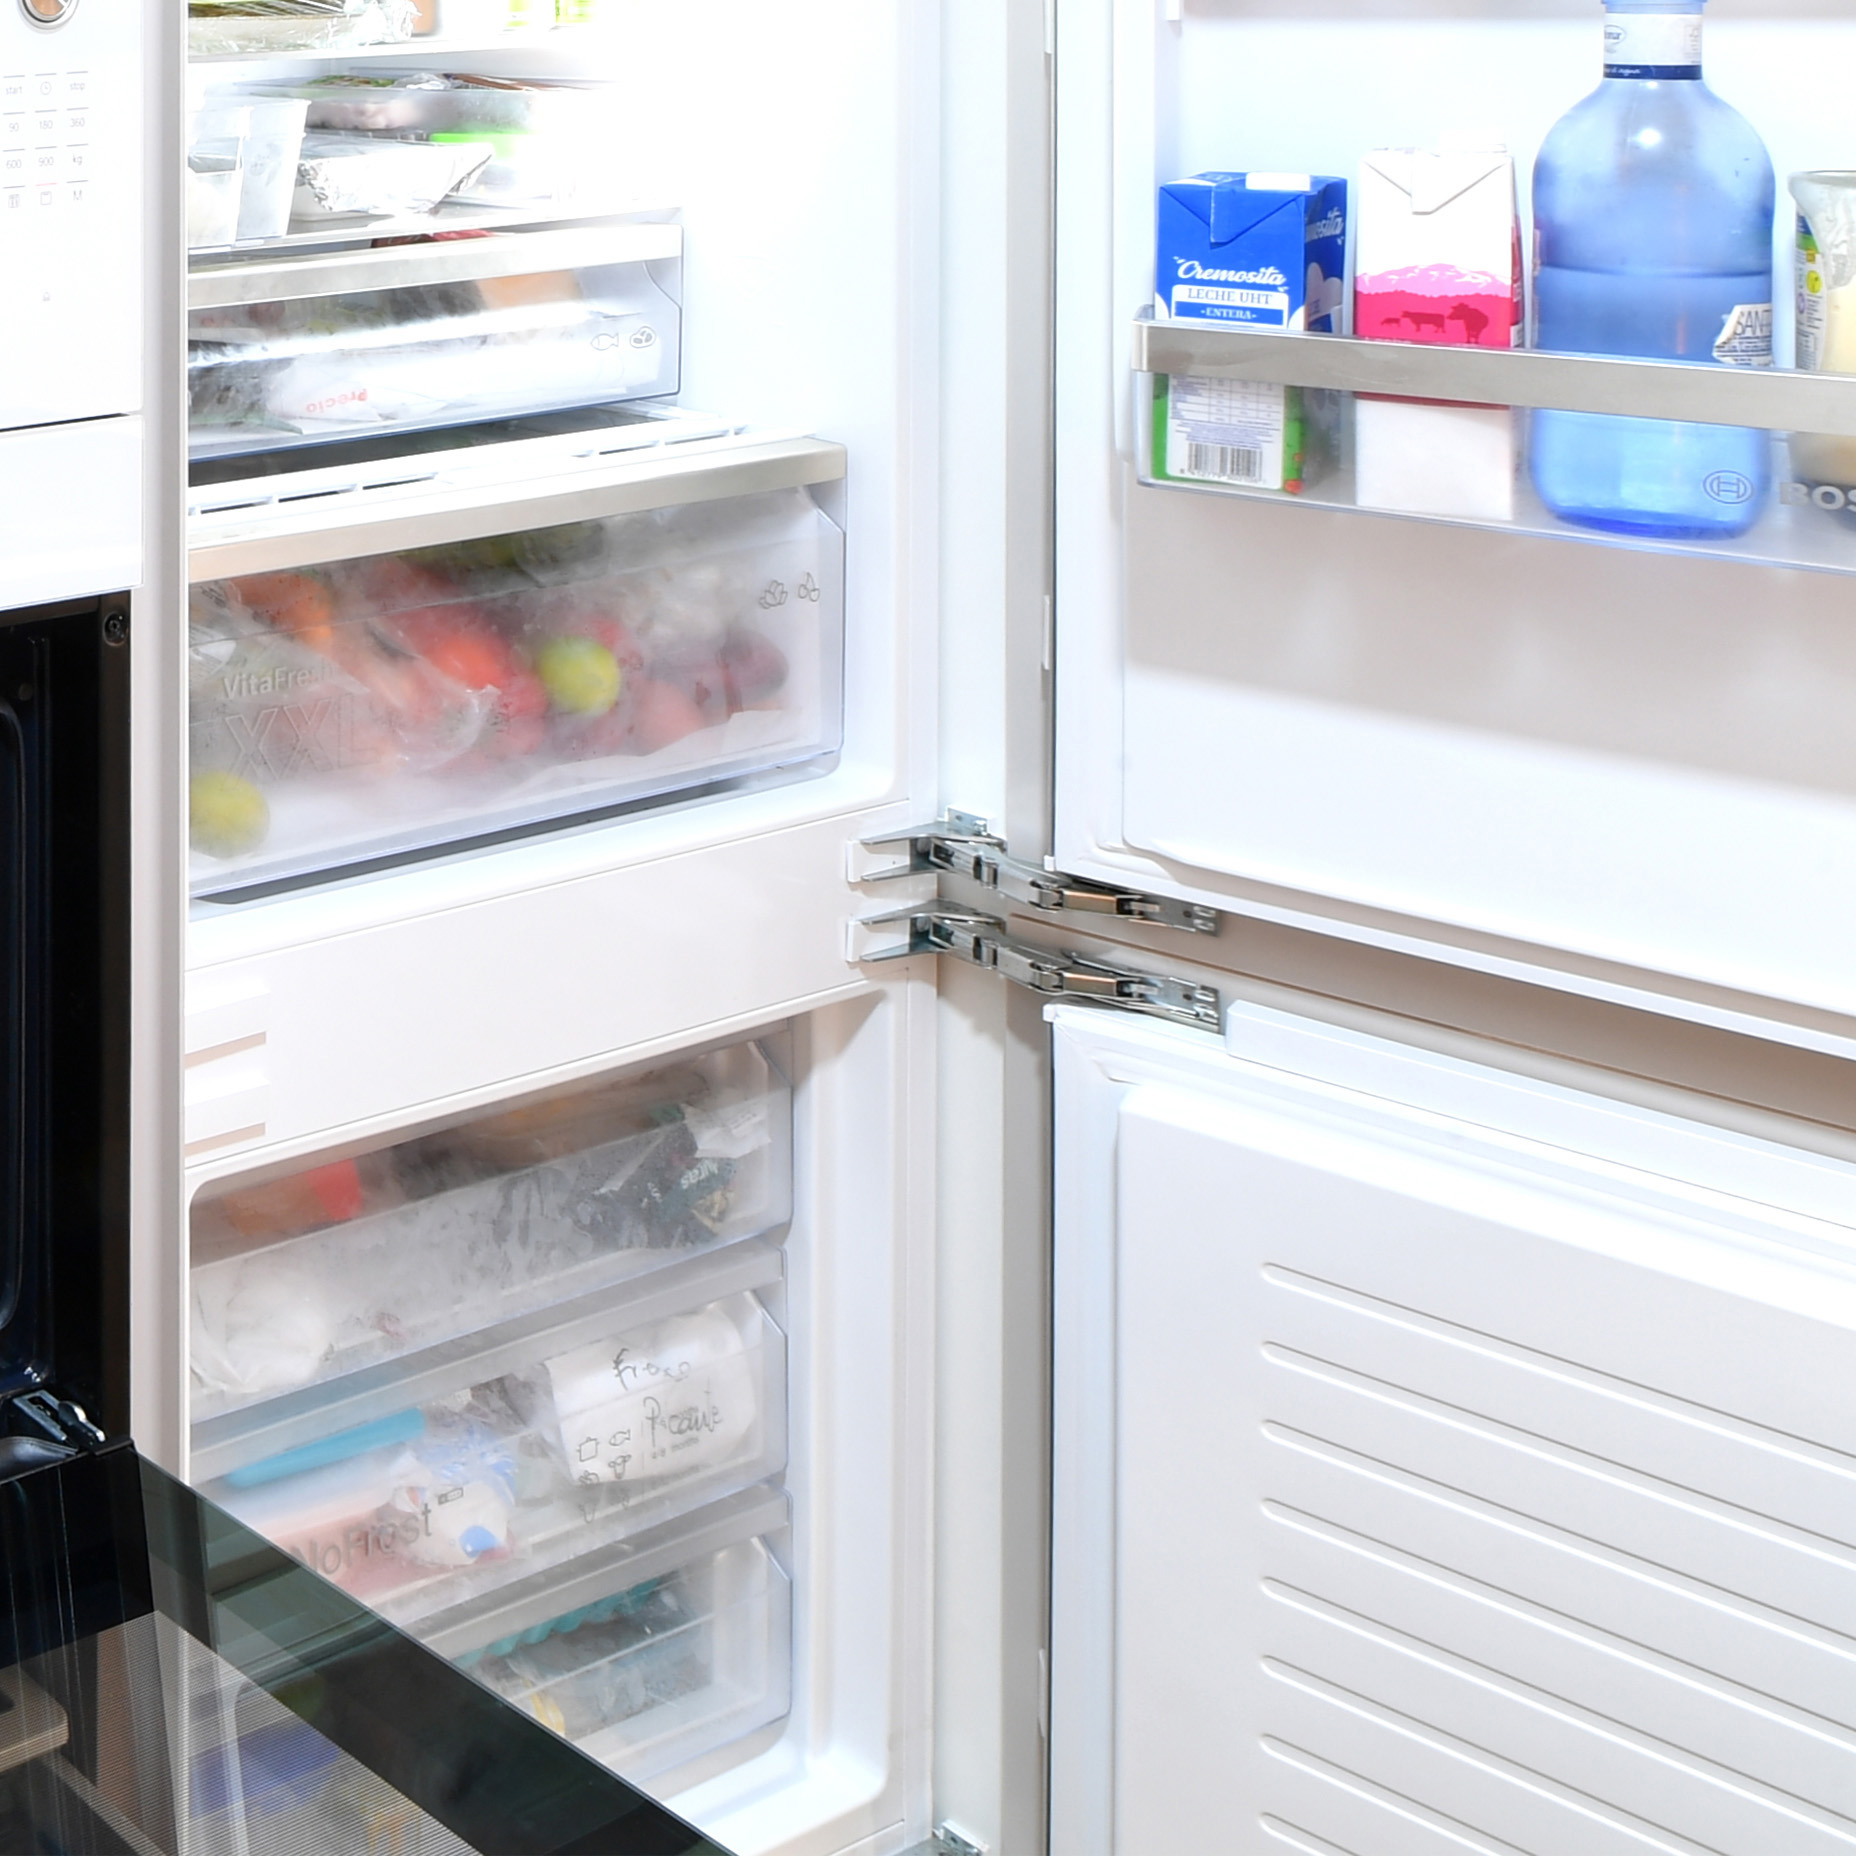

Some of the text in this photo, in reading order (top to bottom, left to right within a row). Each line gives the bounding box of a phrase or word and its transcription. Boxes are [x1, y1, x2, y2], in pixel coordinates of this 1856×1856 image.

[9, 122, 20, 132] 90
[6, 158, 22, 169] 600
[38, 156, 55, 167] 900
[1176, 257, 1288, 289] Cremosita
[1187, 287, 1274, 306] LECHE UHT
